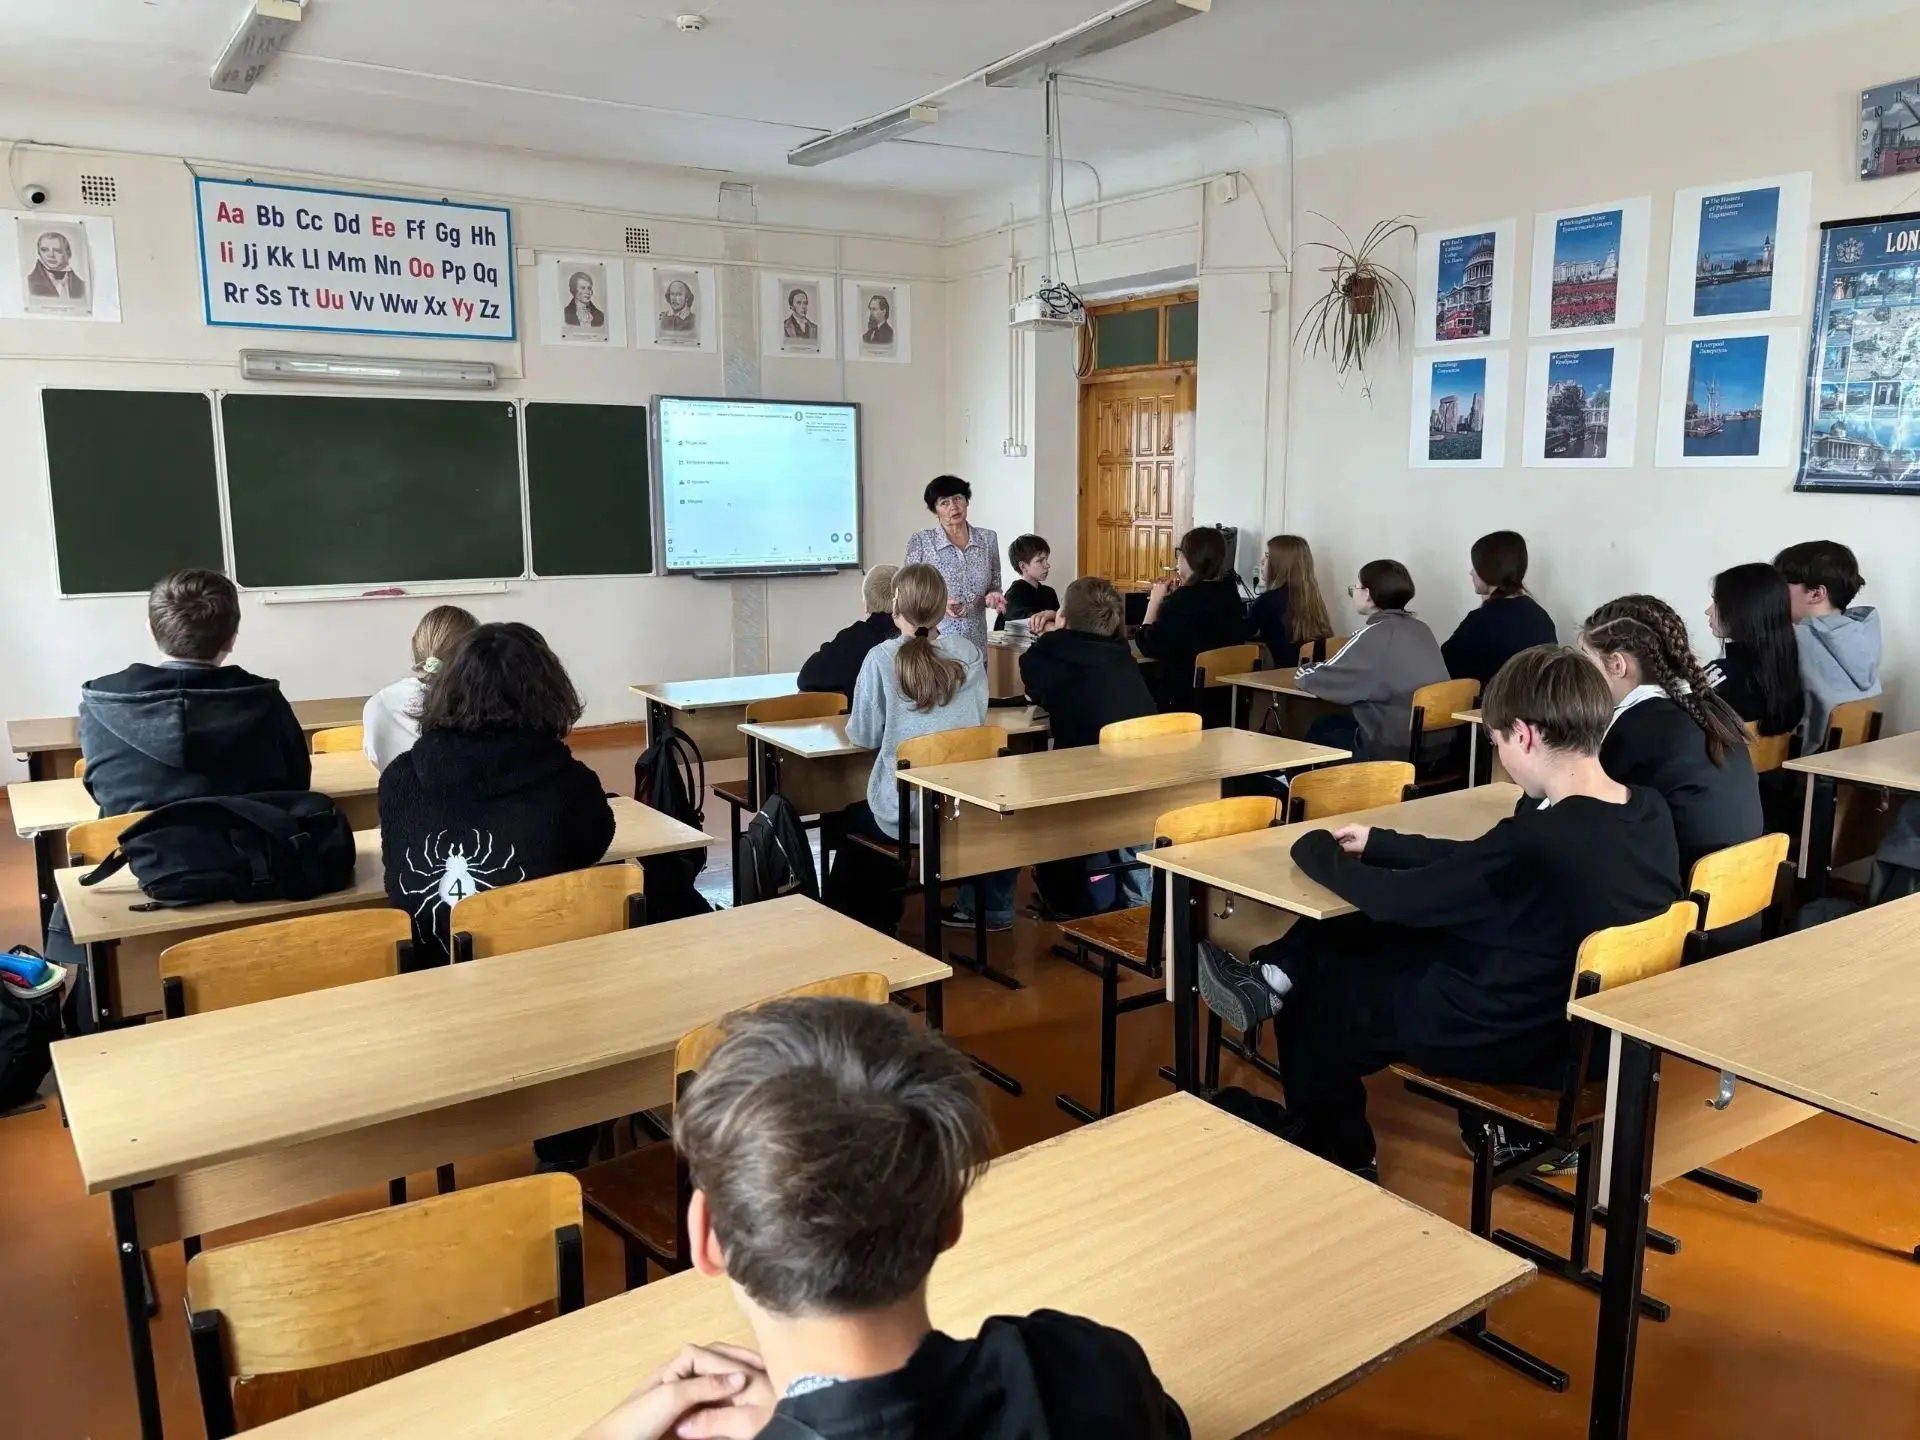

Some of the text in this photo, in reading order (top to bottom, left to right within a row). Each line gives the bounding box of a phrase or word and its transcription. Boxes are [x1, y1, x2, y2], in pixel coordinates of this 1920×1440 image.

[1862, 129, 1868, 140] 9
[1874, 147, 1880, 158] 8
[216, 201, 497, 249] Aa Bb Cc Dd Ee Ff Gg Hh
[1886, 229, 1920, 253] LON
[220, 240, 498, 288] Ii Jj Kk Ll Mm Nn Oo Pp Qq
[223, 281, 501, 323] Rr Ss Tt Uu Vv Ww Xx Yy Zz
[448, 878, 467, 901] 4
